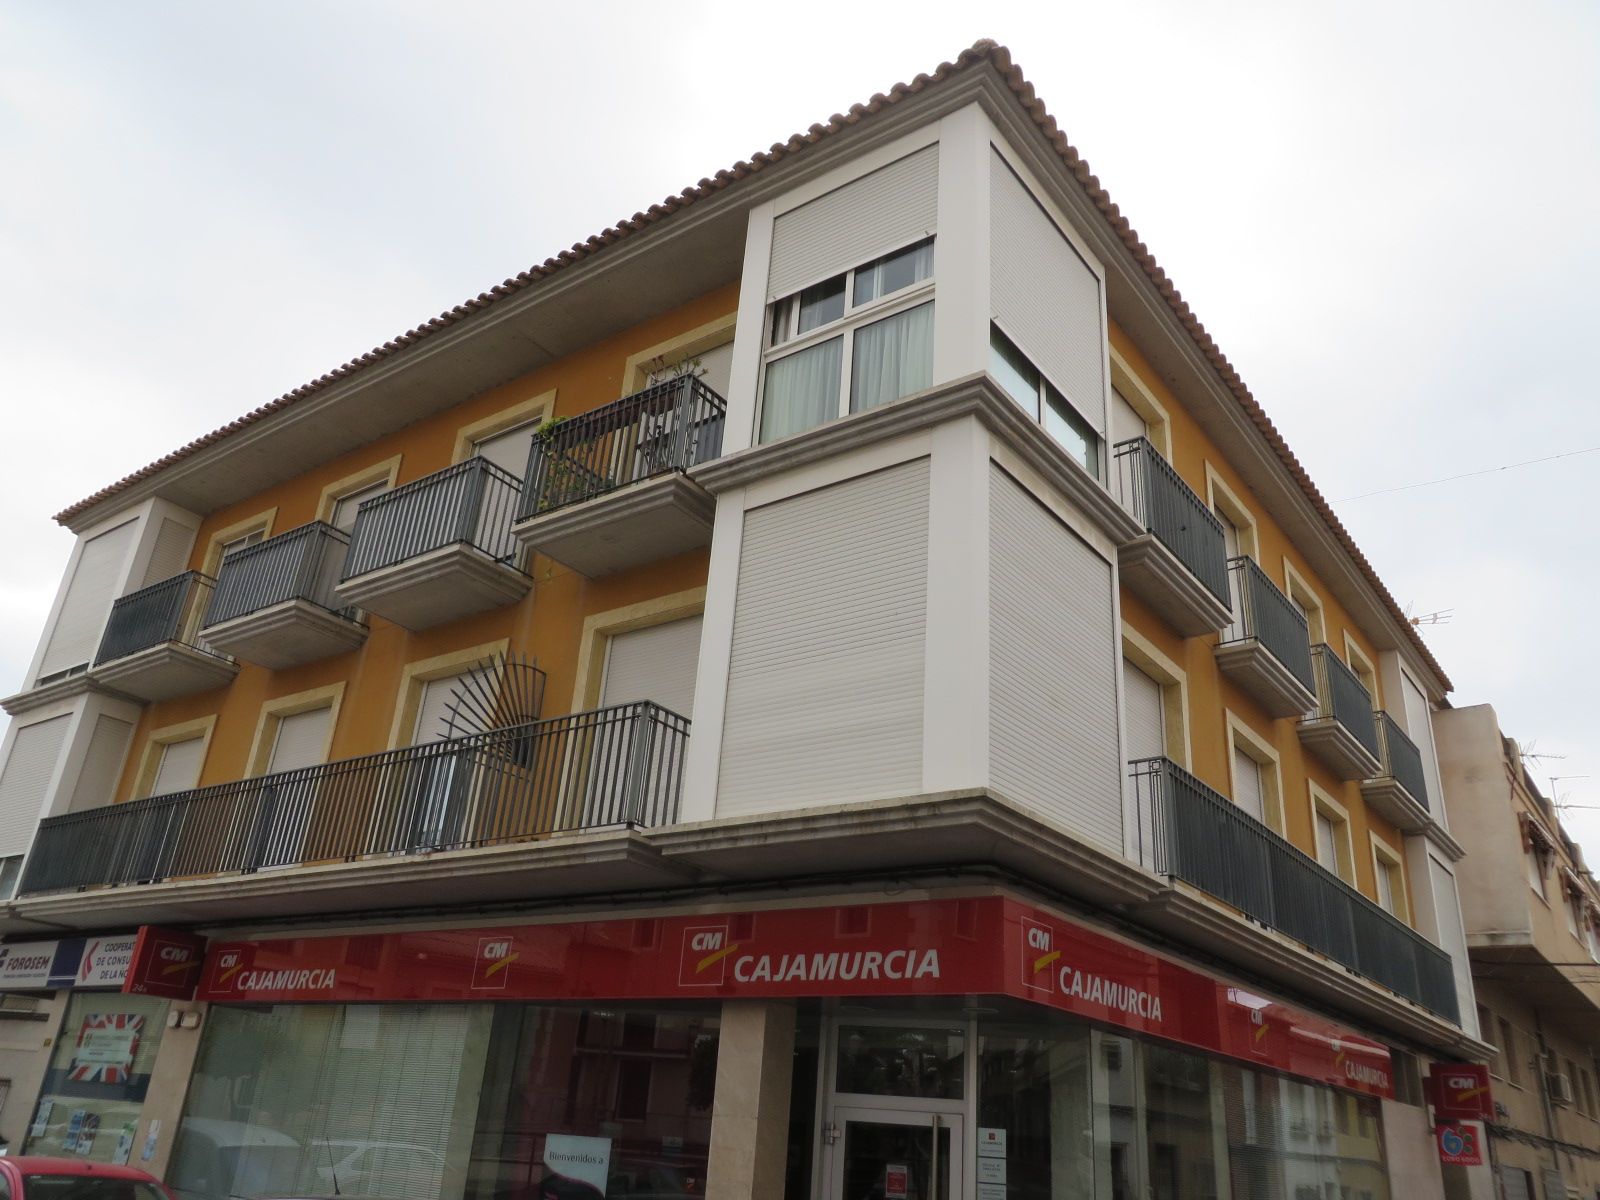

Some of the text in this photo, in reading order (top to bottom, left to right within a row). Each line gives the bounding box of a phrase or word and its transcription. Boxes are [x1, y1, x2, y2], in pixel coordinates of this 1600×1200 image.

[691, 932, 723, 951] CM
[1028, 927, 1050, 952] CM
[160, 946, 190, 962] CM
[483, 942, 509, 959] CM
[6, 956, 51, 971] FOROSEM
[96, 956, 106, 967] DE
[220, 954, 238, 968] CM
[734, 948, 941, 983] CAJAMURCIA
[100, 970, 109, 980] DE
[109, 970, 118, 979] LA
[237, 968, 336, 991] CAJAMURCIA
[1059, 965, 1163, 1023] CAJAMURCIA
[1251, 1007, 1263, 1025] CM
[1345, 1060, 1389, 1089] CAJAMURCIA
[1449, 1078, 1474, 1089] CM
[549, 1151, 604, 1165] Bienvenidos a
